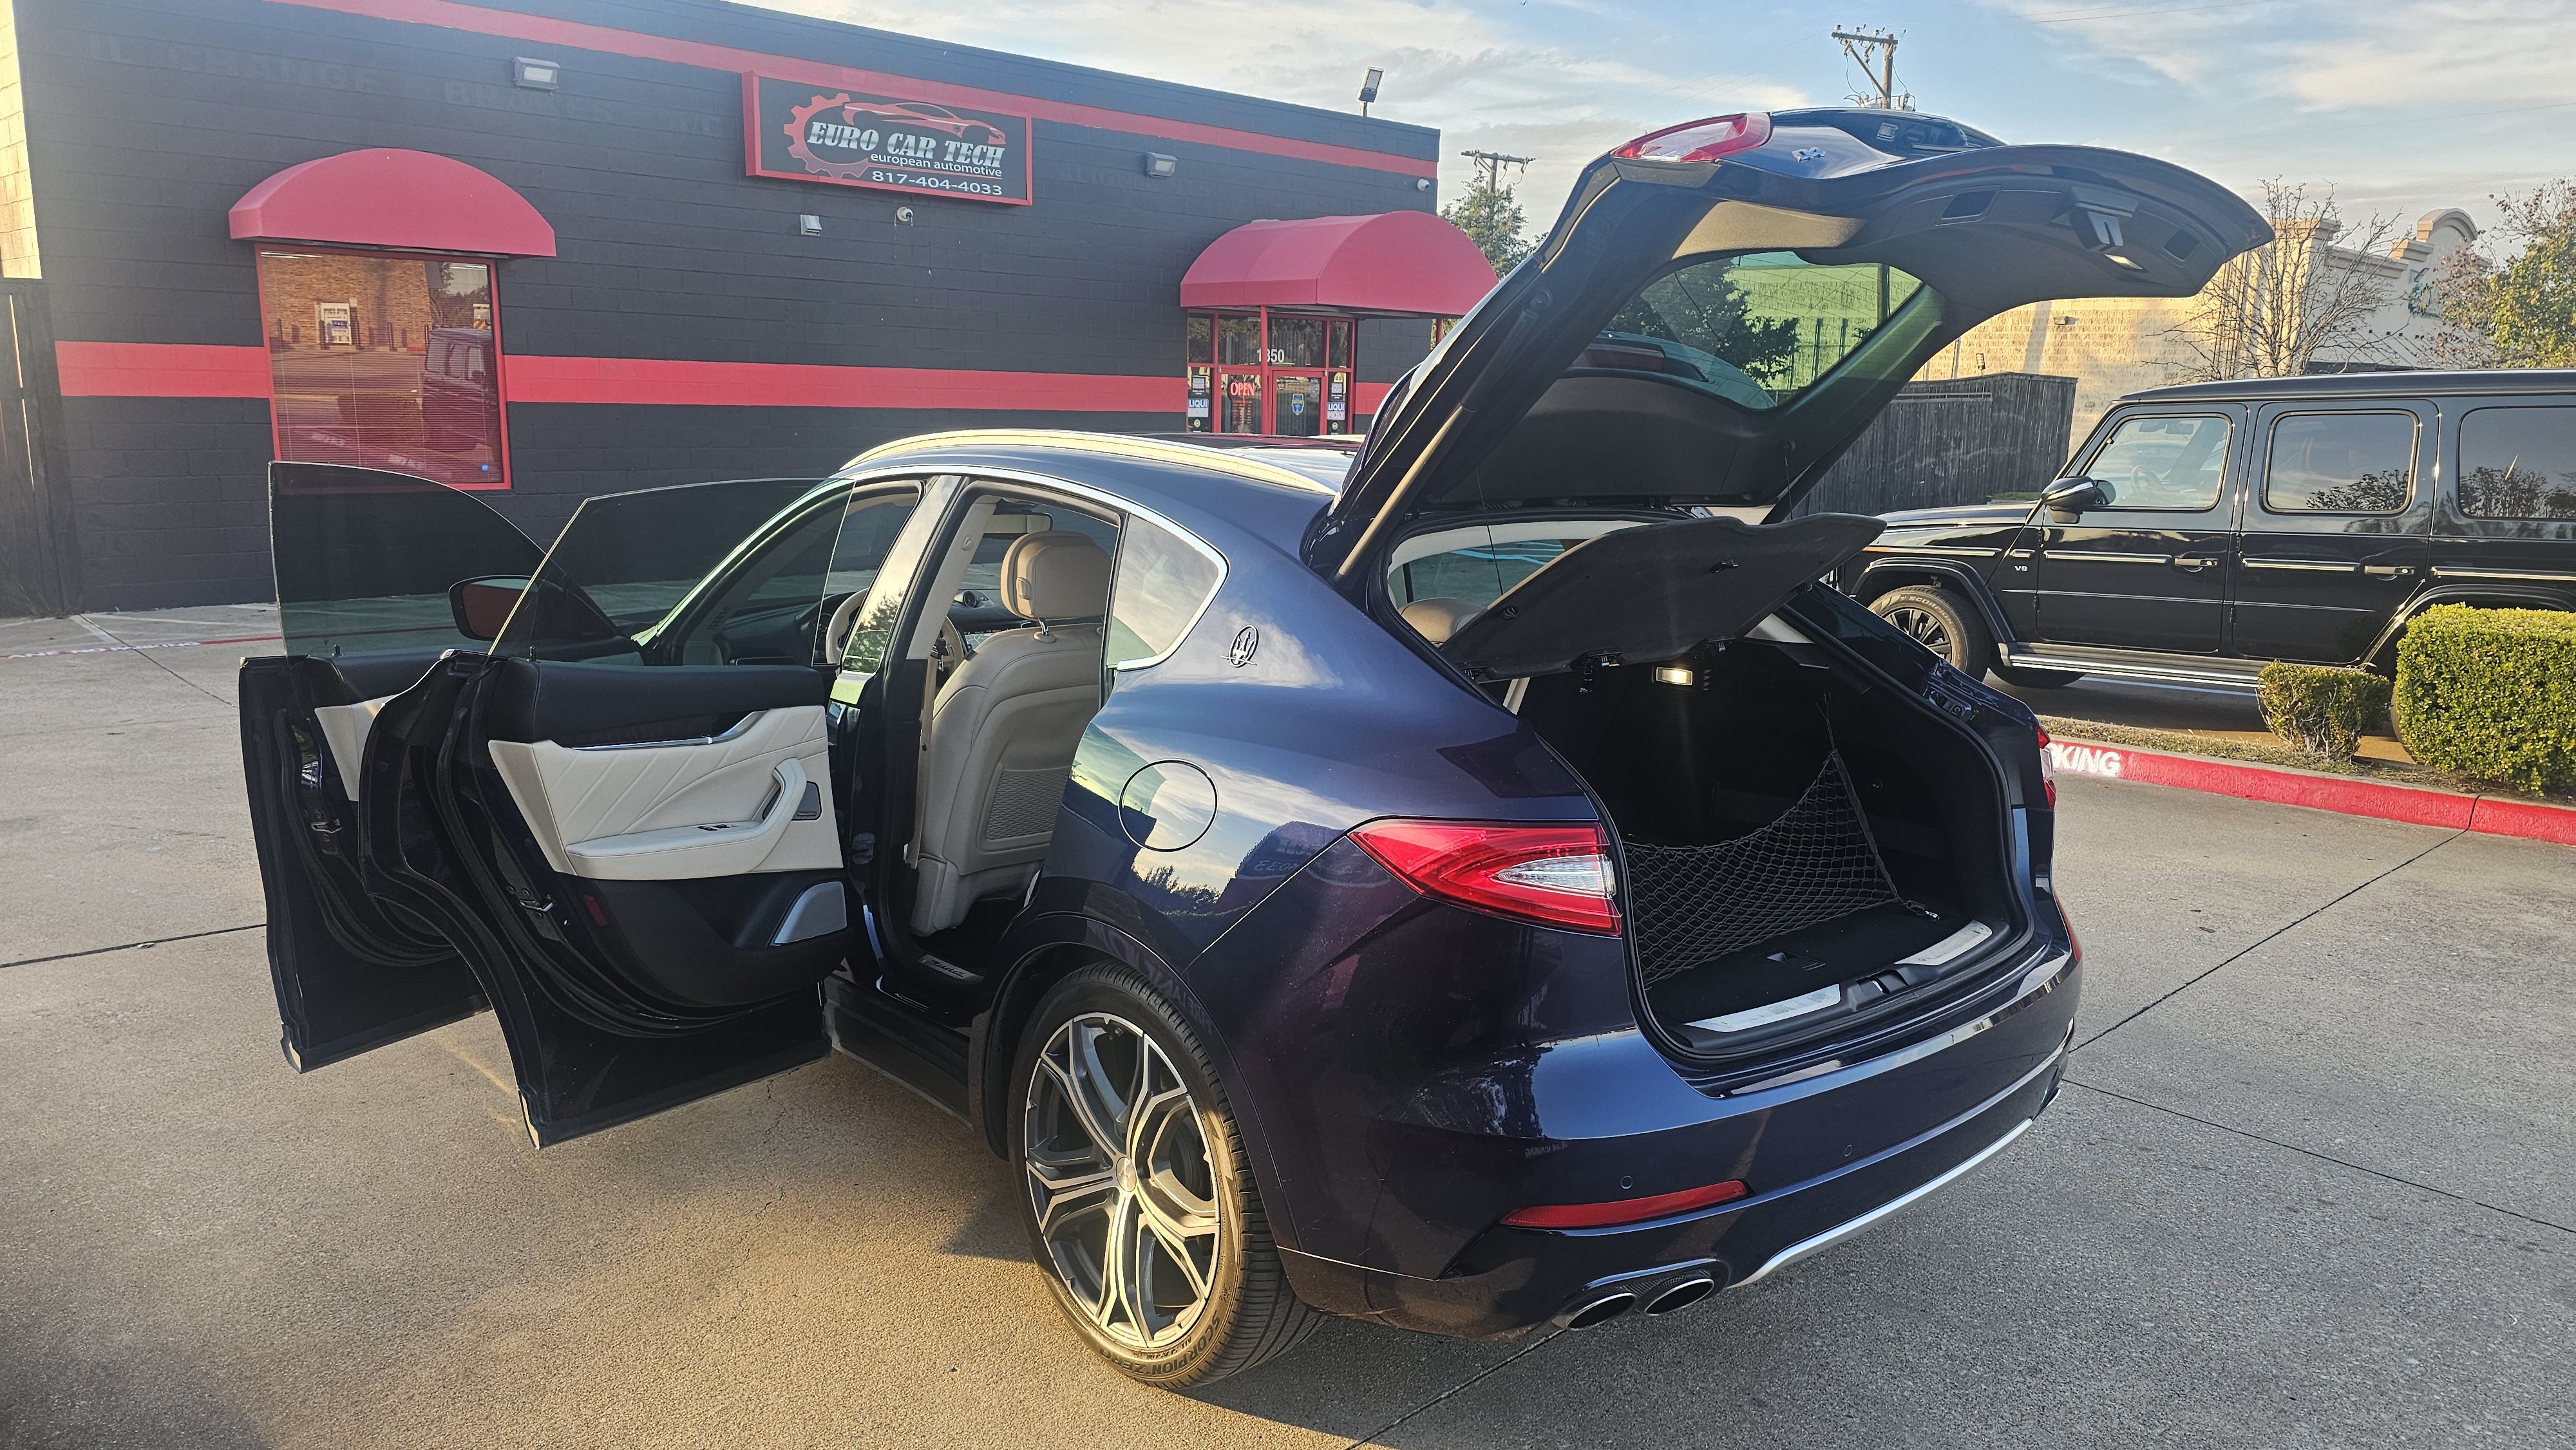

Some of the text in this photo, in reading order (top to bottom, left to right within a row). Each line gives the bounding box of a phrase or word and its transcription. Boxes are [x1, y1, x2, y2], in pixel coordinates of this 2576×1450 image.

[807, 121, 1005, 167] EURO CAR TECH
[871, 152, 1002, 177] european automotive
[872, 171, 1002, 195] 817-404-4033
[1230, 382, 1255, 396] OPEN
[1189, 399, 1208, 408] LIQUI
[1328, 403, 1345, 411] LIQUI
[1908, 596, 1953, 624] SCORPION
[1099, 1309, 1220, 1377] SCORPION ZERO
